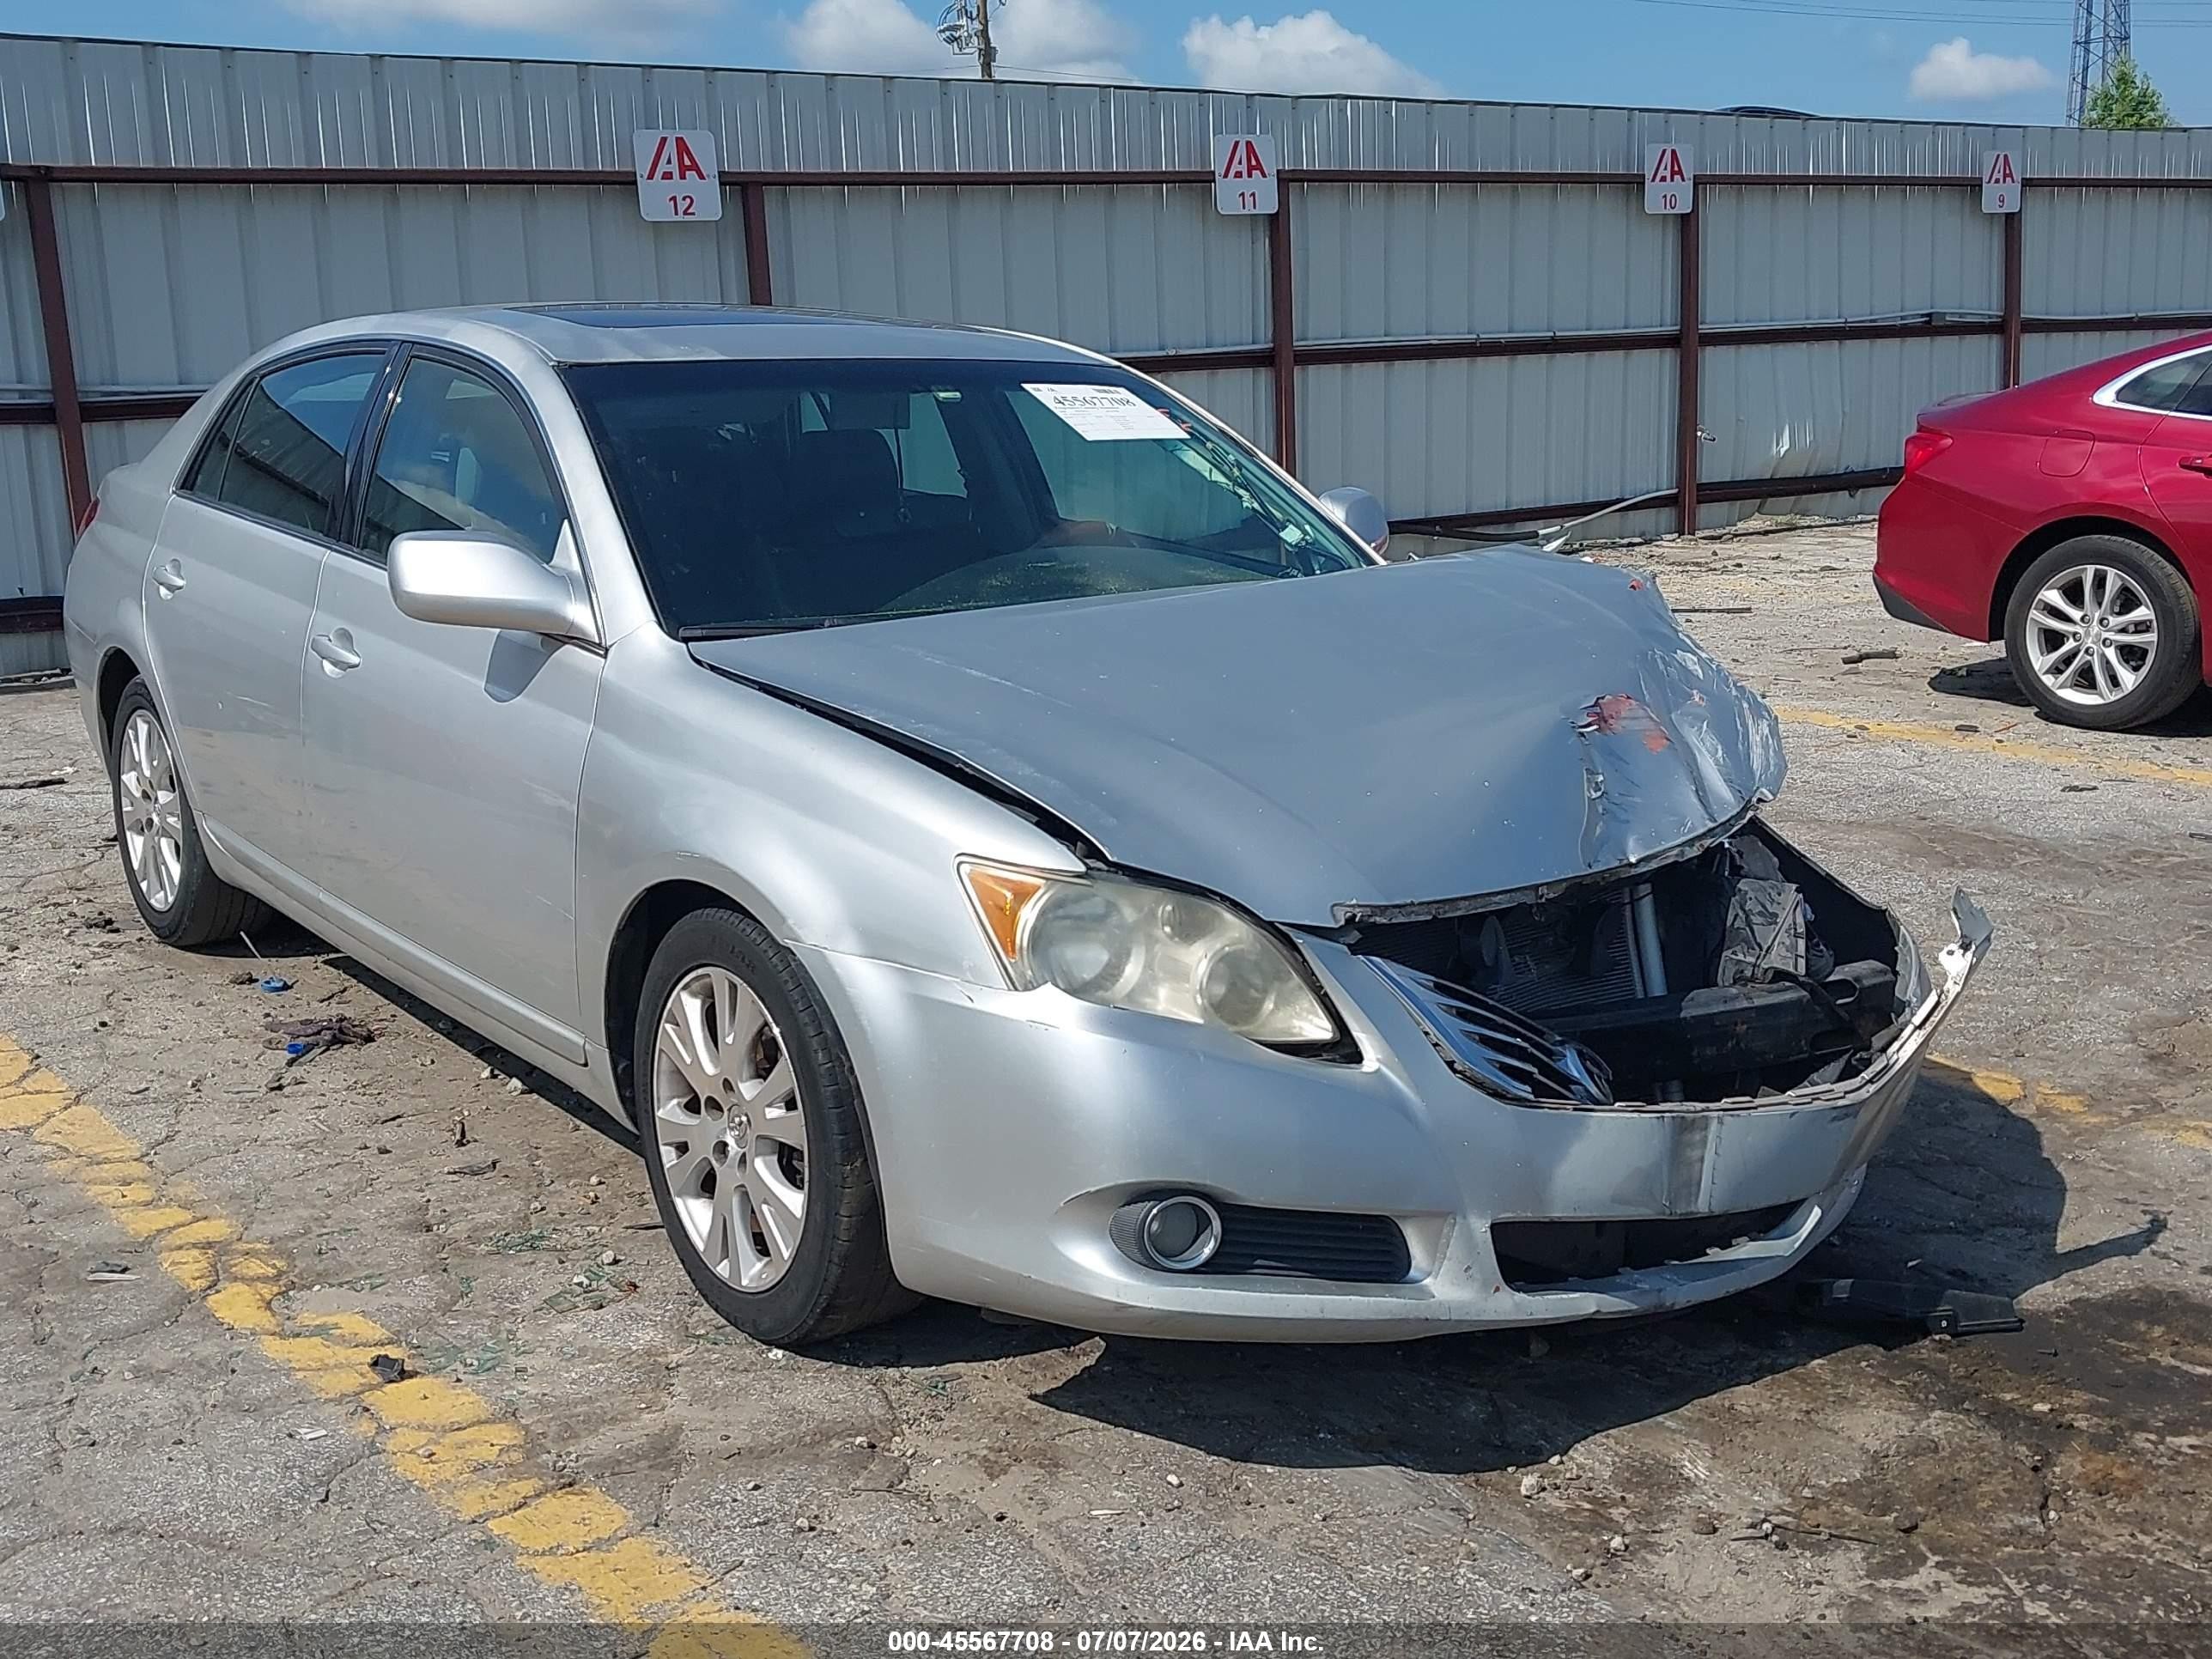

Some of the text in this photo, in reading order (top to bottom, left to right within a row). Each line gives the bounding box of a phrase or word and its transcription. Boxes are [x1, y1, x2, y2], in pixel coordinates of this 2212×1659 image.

[668, 195, 696, 216] 12
[1238, 191, 1257, 210] 11
[1662, 193, 1677, 210] 10
[1998, 193, 2006, 208] 9
